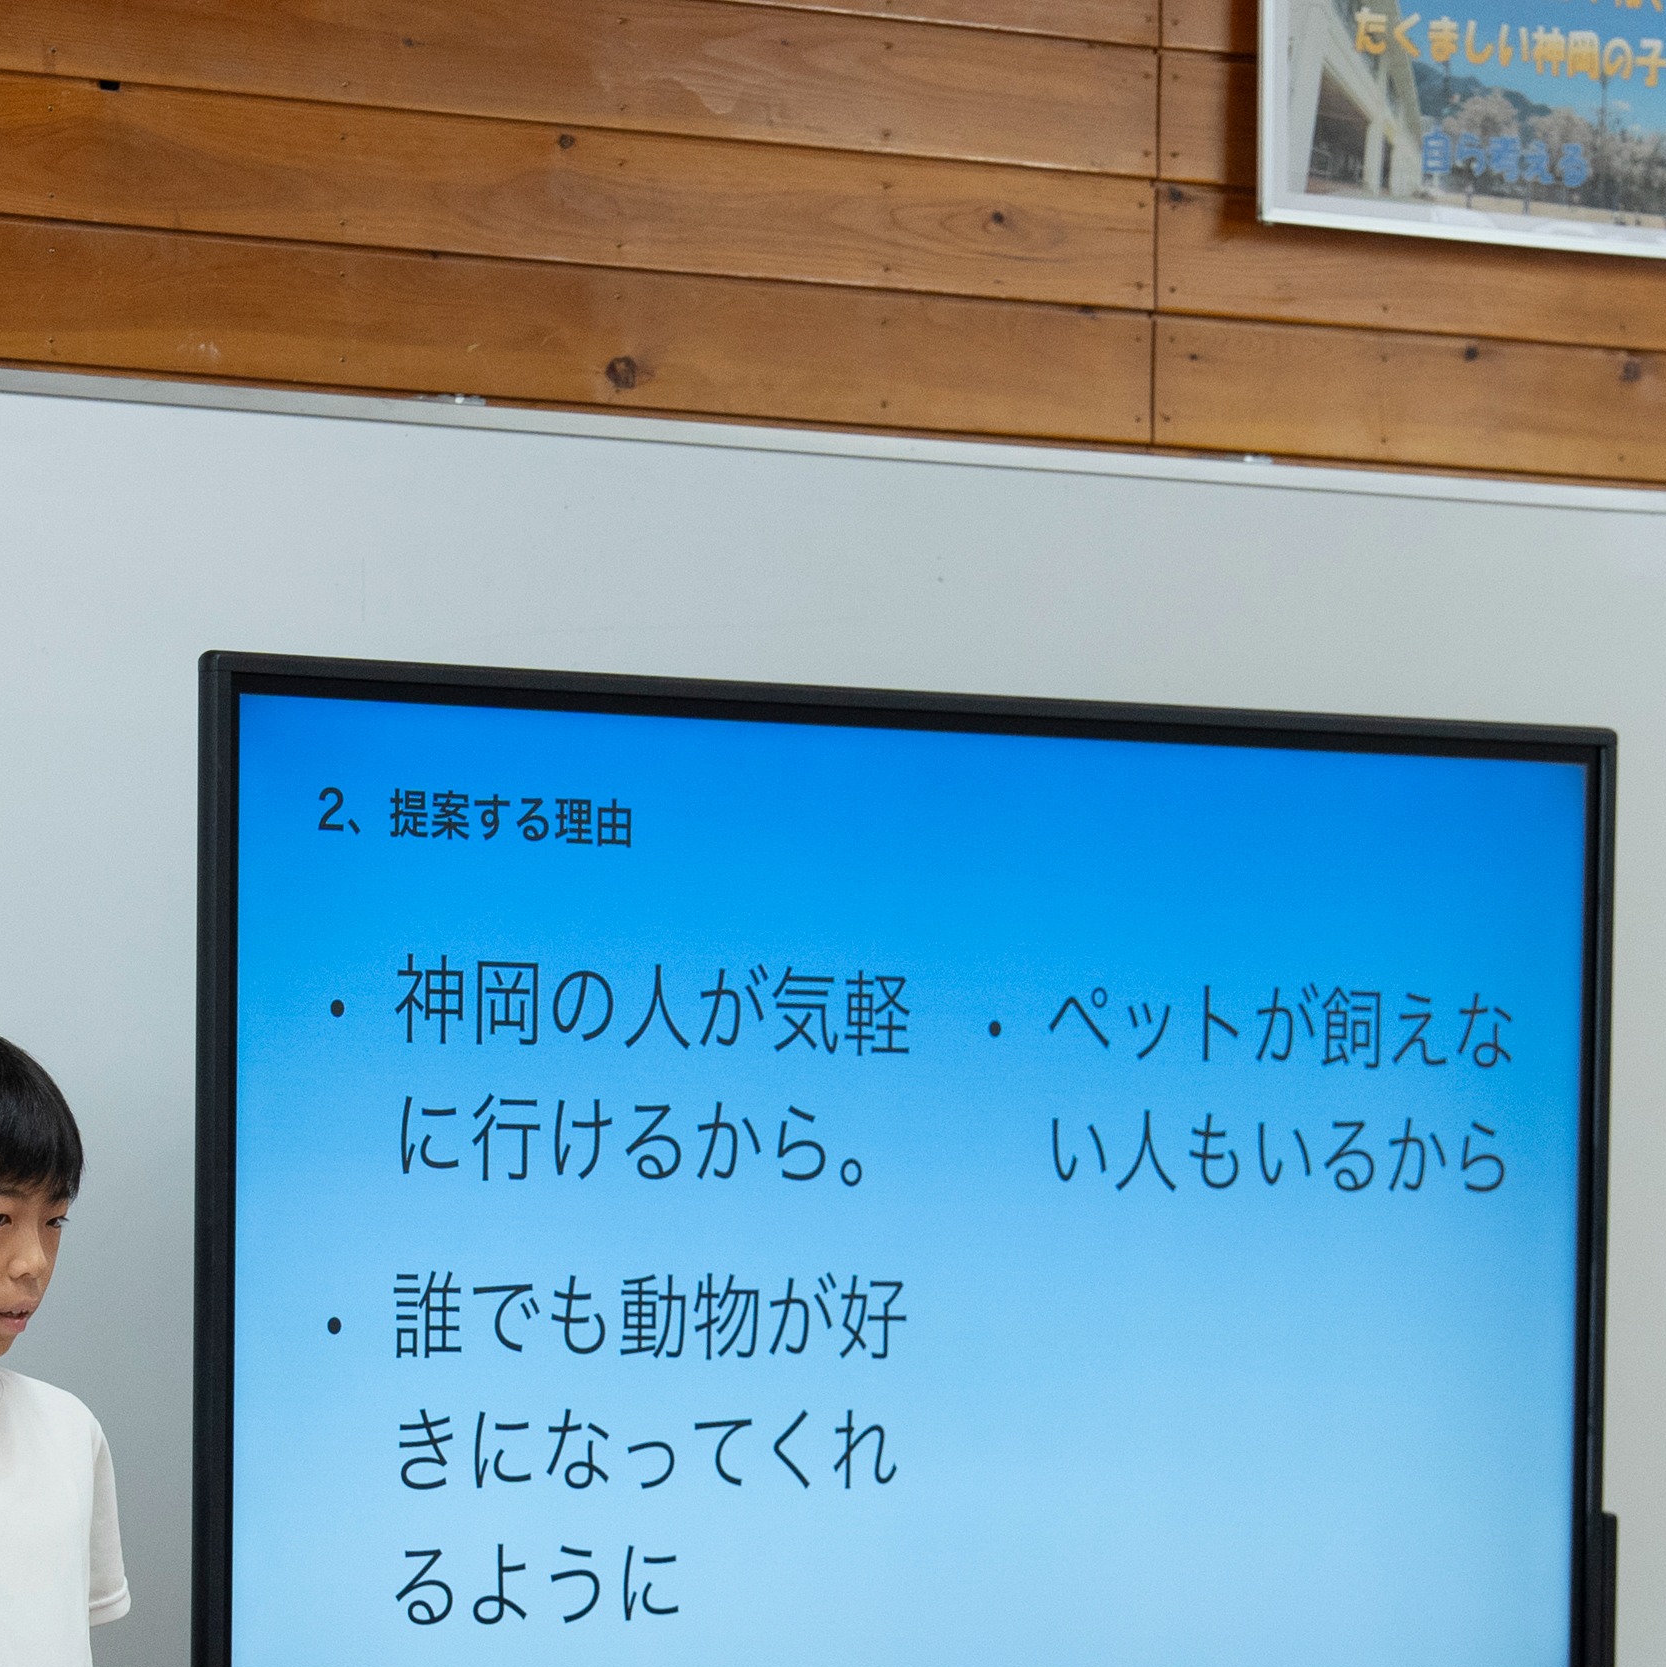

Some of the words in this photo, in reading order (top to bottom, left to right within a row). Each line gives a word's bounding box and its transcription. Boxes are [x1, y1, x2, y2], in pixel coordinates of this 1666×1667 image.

[319, 787, 632, 847] 2、提案する理由
[395, 953, 910, 1057] 神岡の人が気軽
[1049, 984, 1513, 1069] ペットが飼えな
[399, 1094, 864, 1187] に行けるから。
[1051, 1111, 1507, 1193] い人もいるから
[394, 1271, 908, 1361] 誰でも動物が好
[397, 1409, 898, 1491] きになってくれ
[394, 1544, 679, 1626] るように
